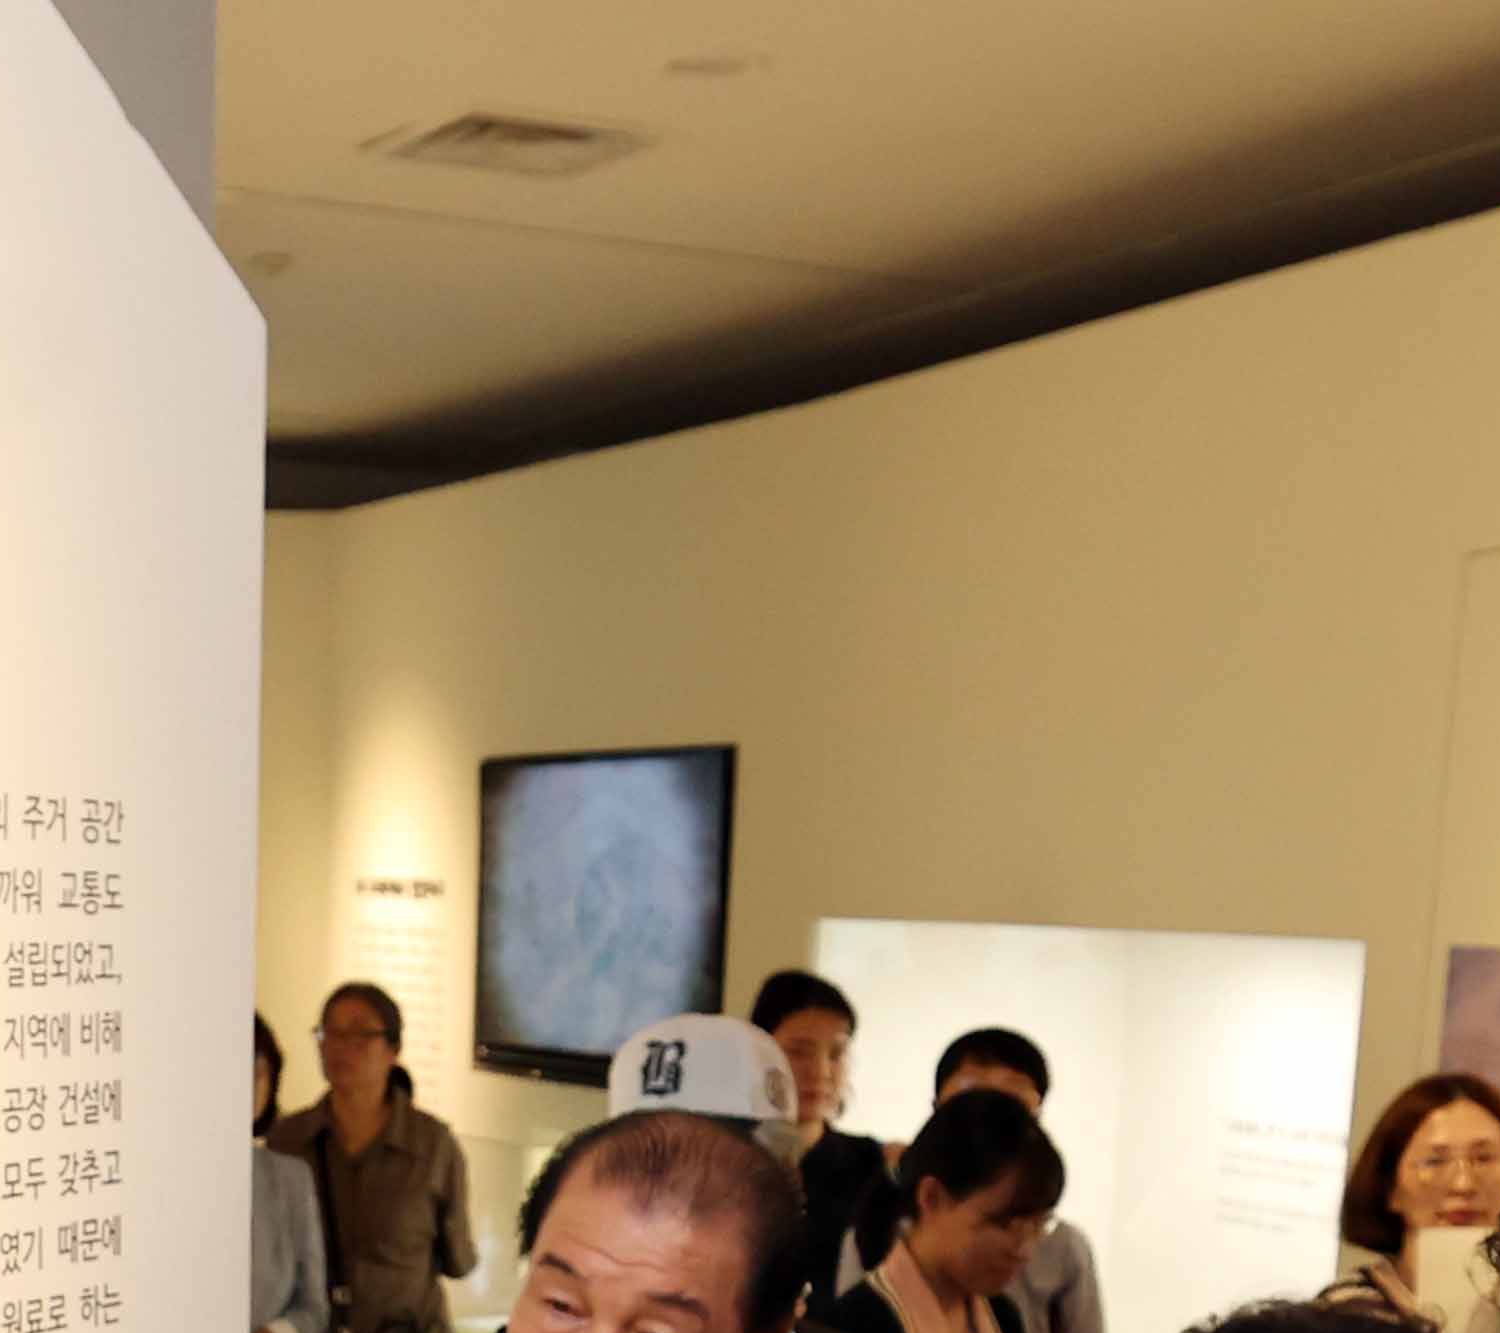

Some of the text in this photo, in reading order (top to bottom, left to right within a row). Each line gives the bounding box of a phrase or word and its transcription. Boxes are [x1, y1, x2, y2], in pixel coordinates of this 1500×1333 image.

[21, 794, 69, 845] 주거
[79, 797, 126, 846] 공간
[56, 869, 130, 917] 교통도
[2, 940, 124, 989] 설립되었고,
[2, 1010, 72, 1062] 지역에
[78, 1009, 124, 1056] 비해
[1, 1085, 49, 1135] 공장
[57, 1078, 124, 1128] 건설에
[0, 1155, 49, 1202] 모두
[57, 1148, 124, 1198] 갖추고
[56, 1214, 123, 1265] 때문에
[78, 1282, 124, 1329] 하는
